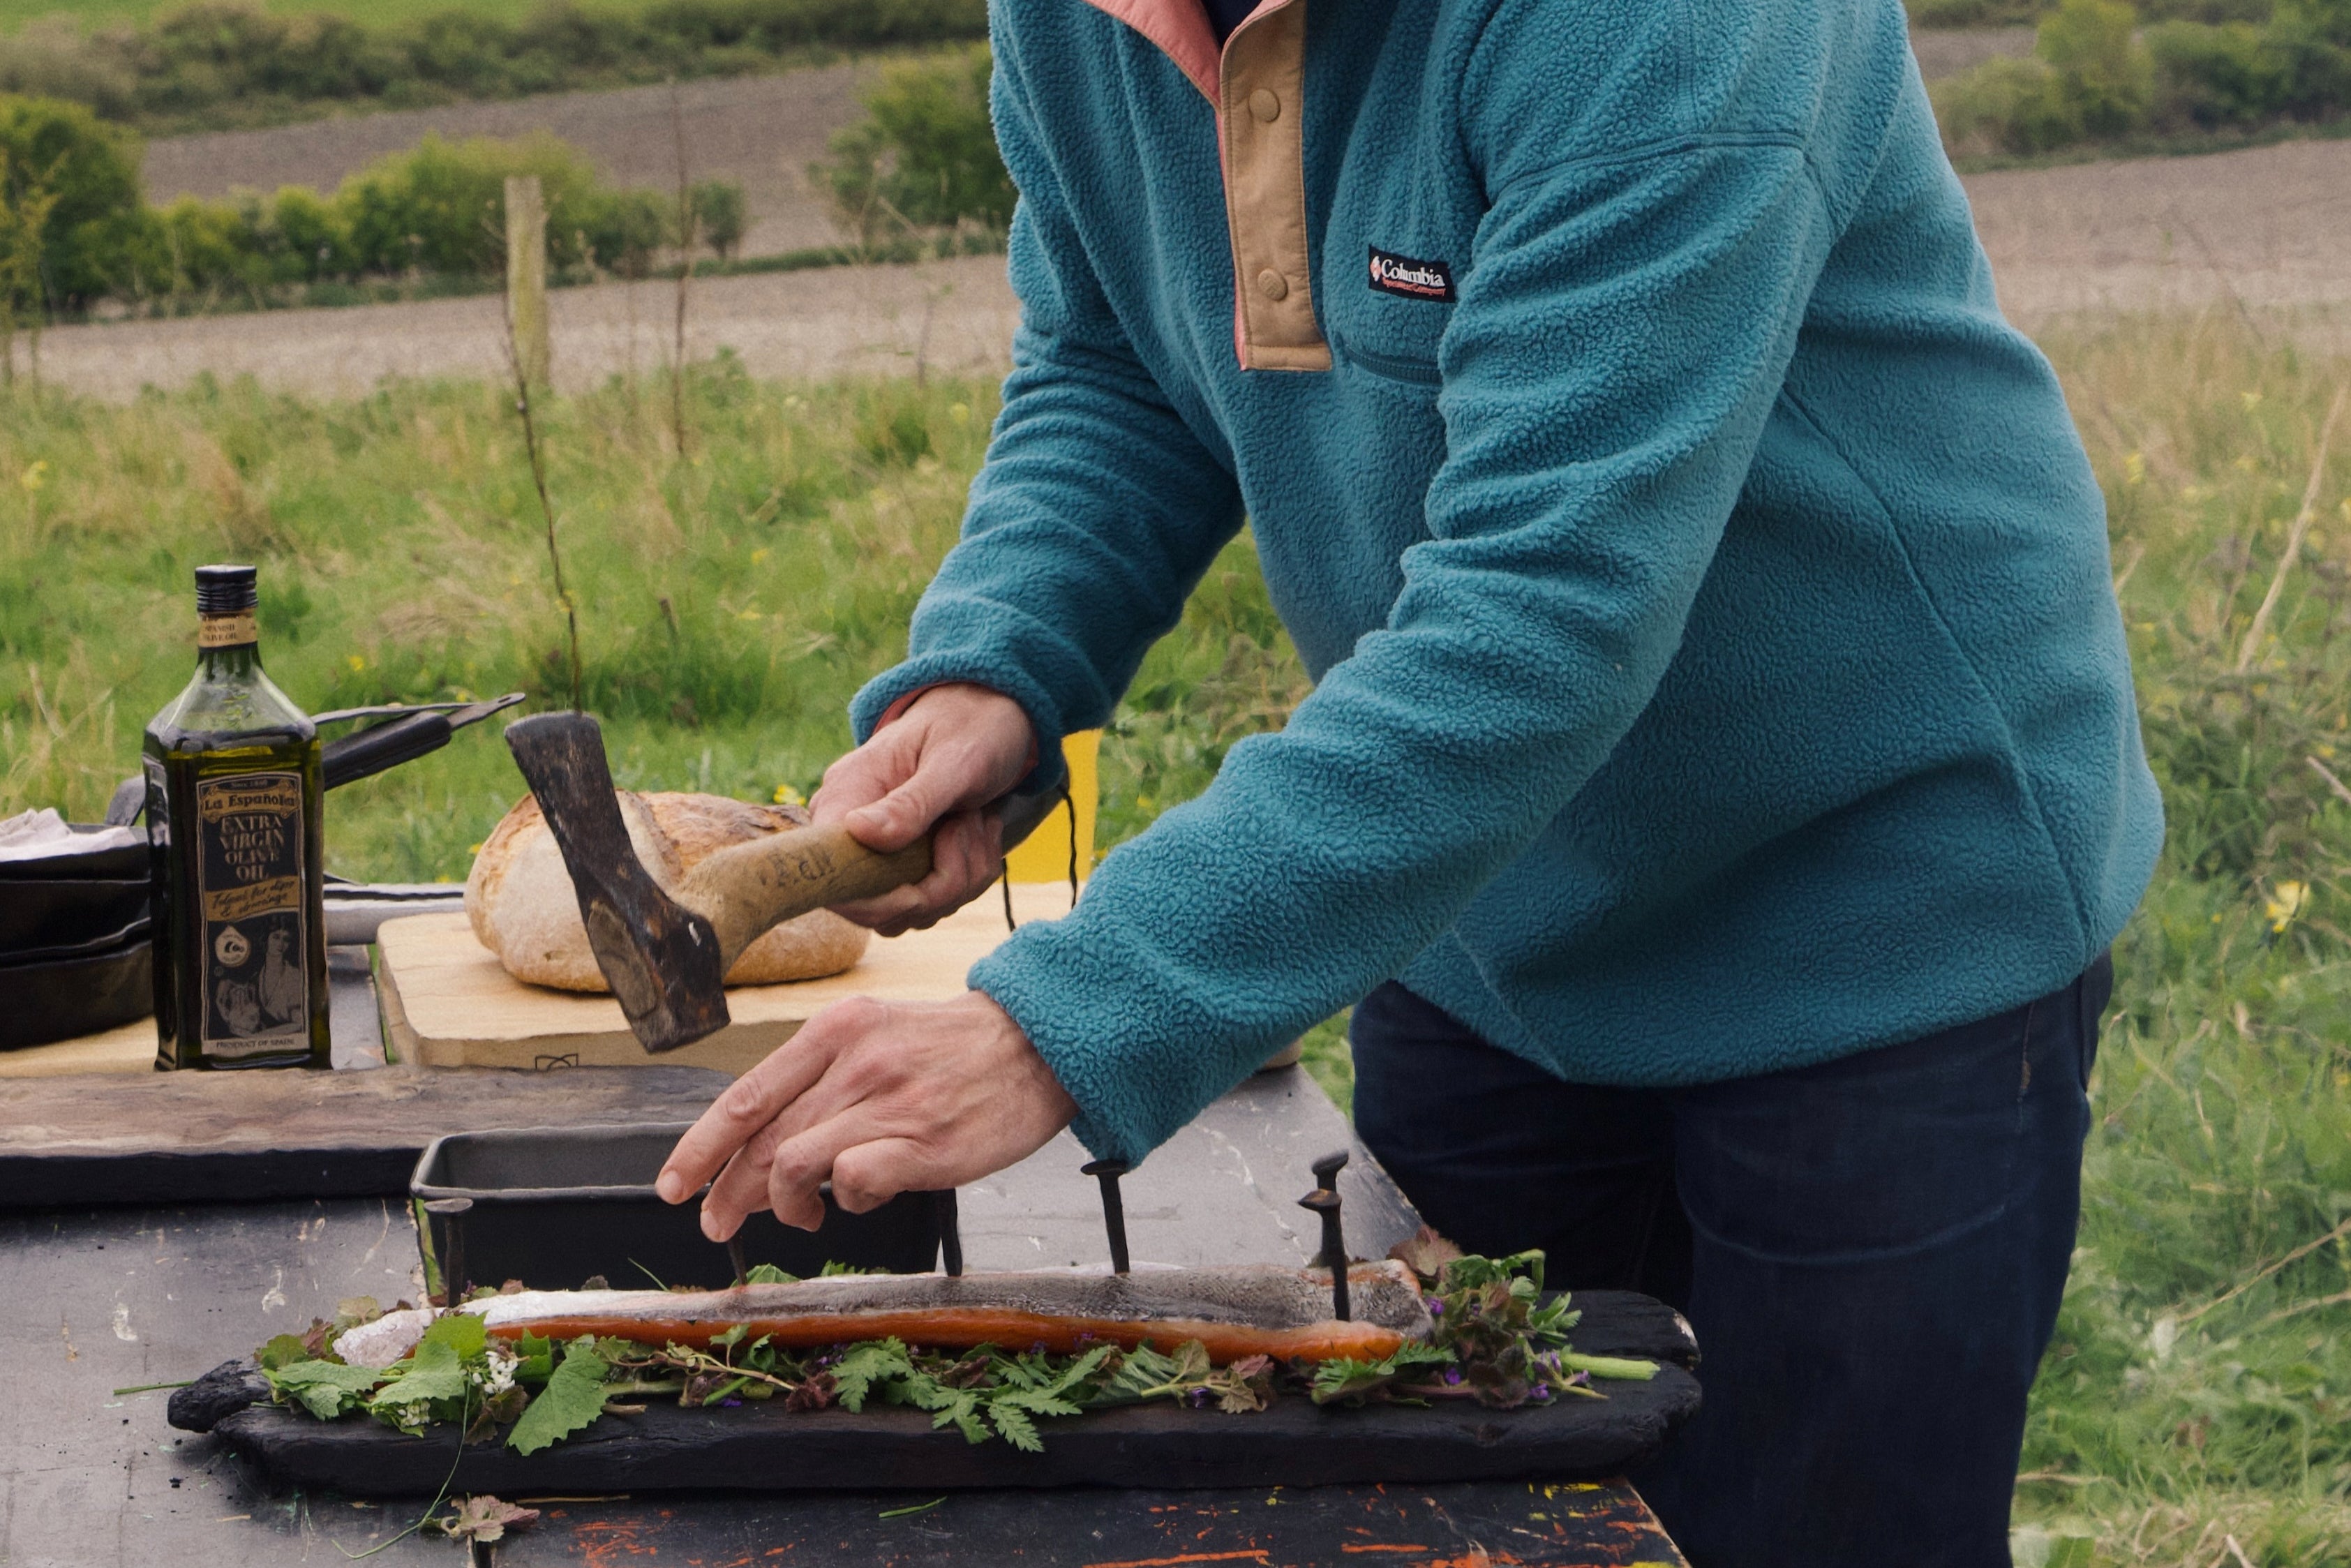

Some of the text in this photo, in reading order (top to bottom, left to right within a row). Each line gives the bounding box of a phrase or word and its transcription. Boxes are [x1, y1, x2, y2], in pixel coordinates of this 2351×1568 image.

[1382, 259, 1445, 288] Columbia
[204, 793, 294, 811] La Española
[221, 815, 283, 833] EXTRA
[220, 829, 285, 850] VIRGIN
[225, 847, 279, 865] OLIVE
[236, 865, 269, 881] OIL
[216, 1039, 256, 1049] PRODUCT
[270, 1037, 294, 1045] SPAIN
